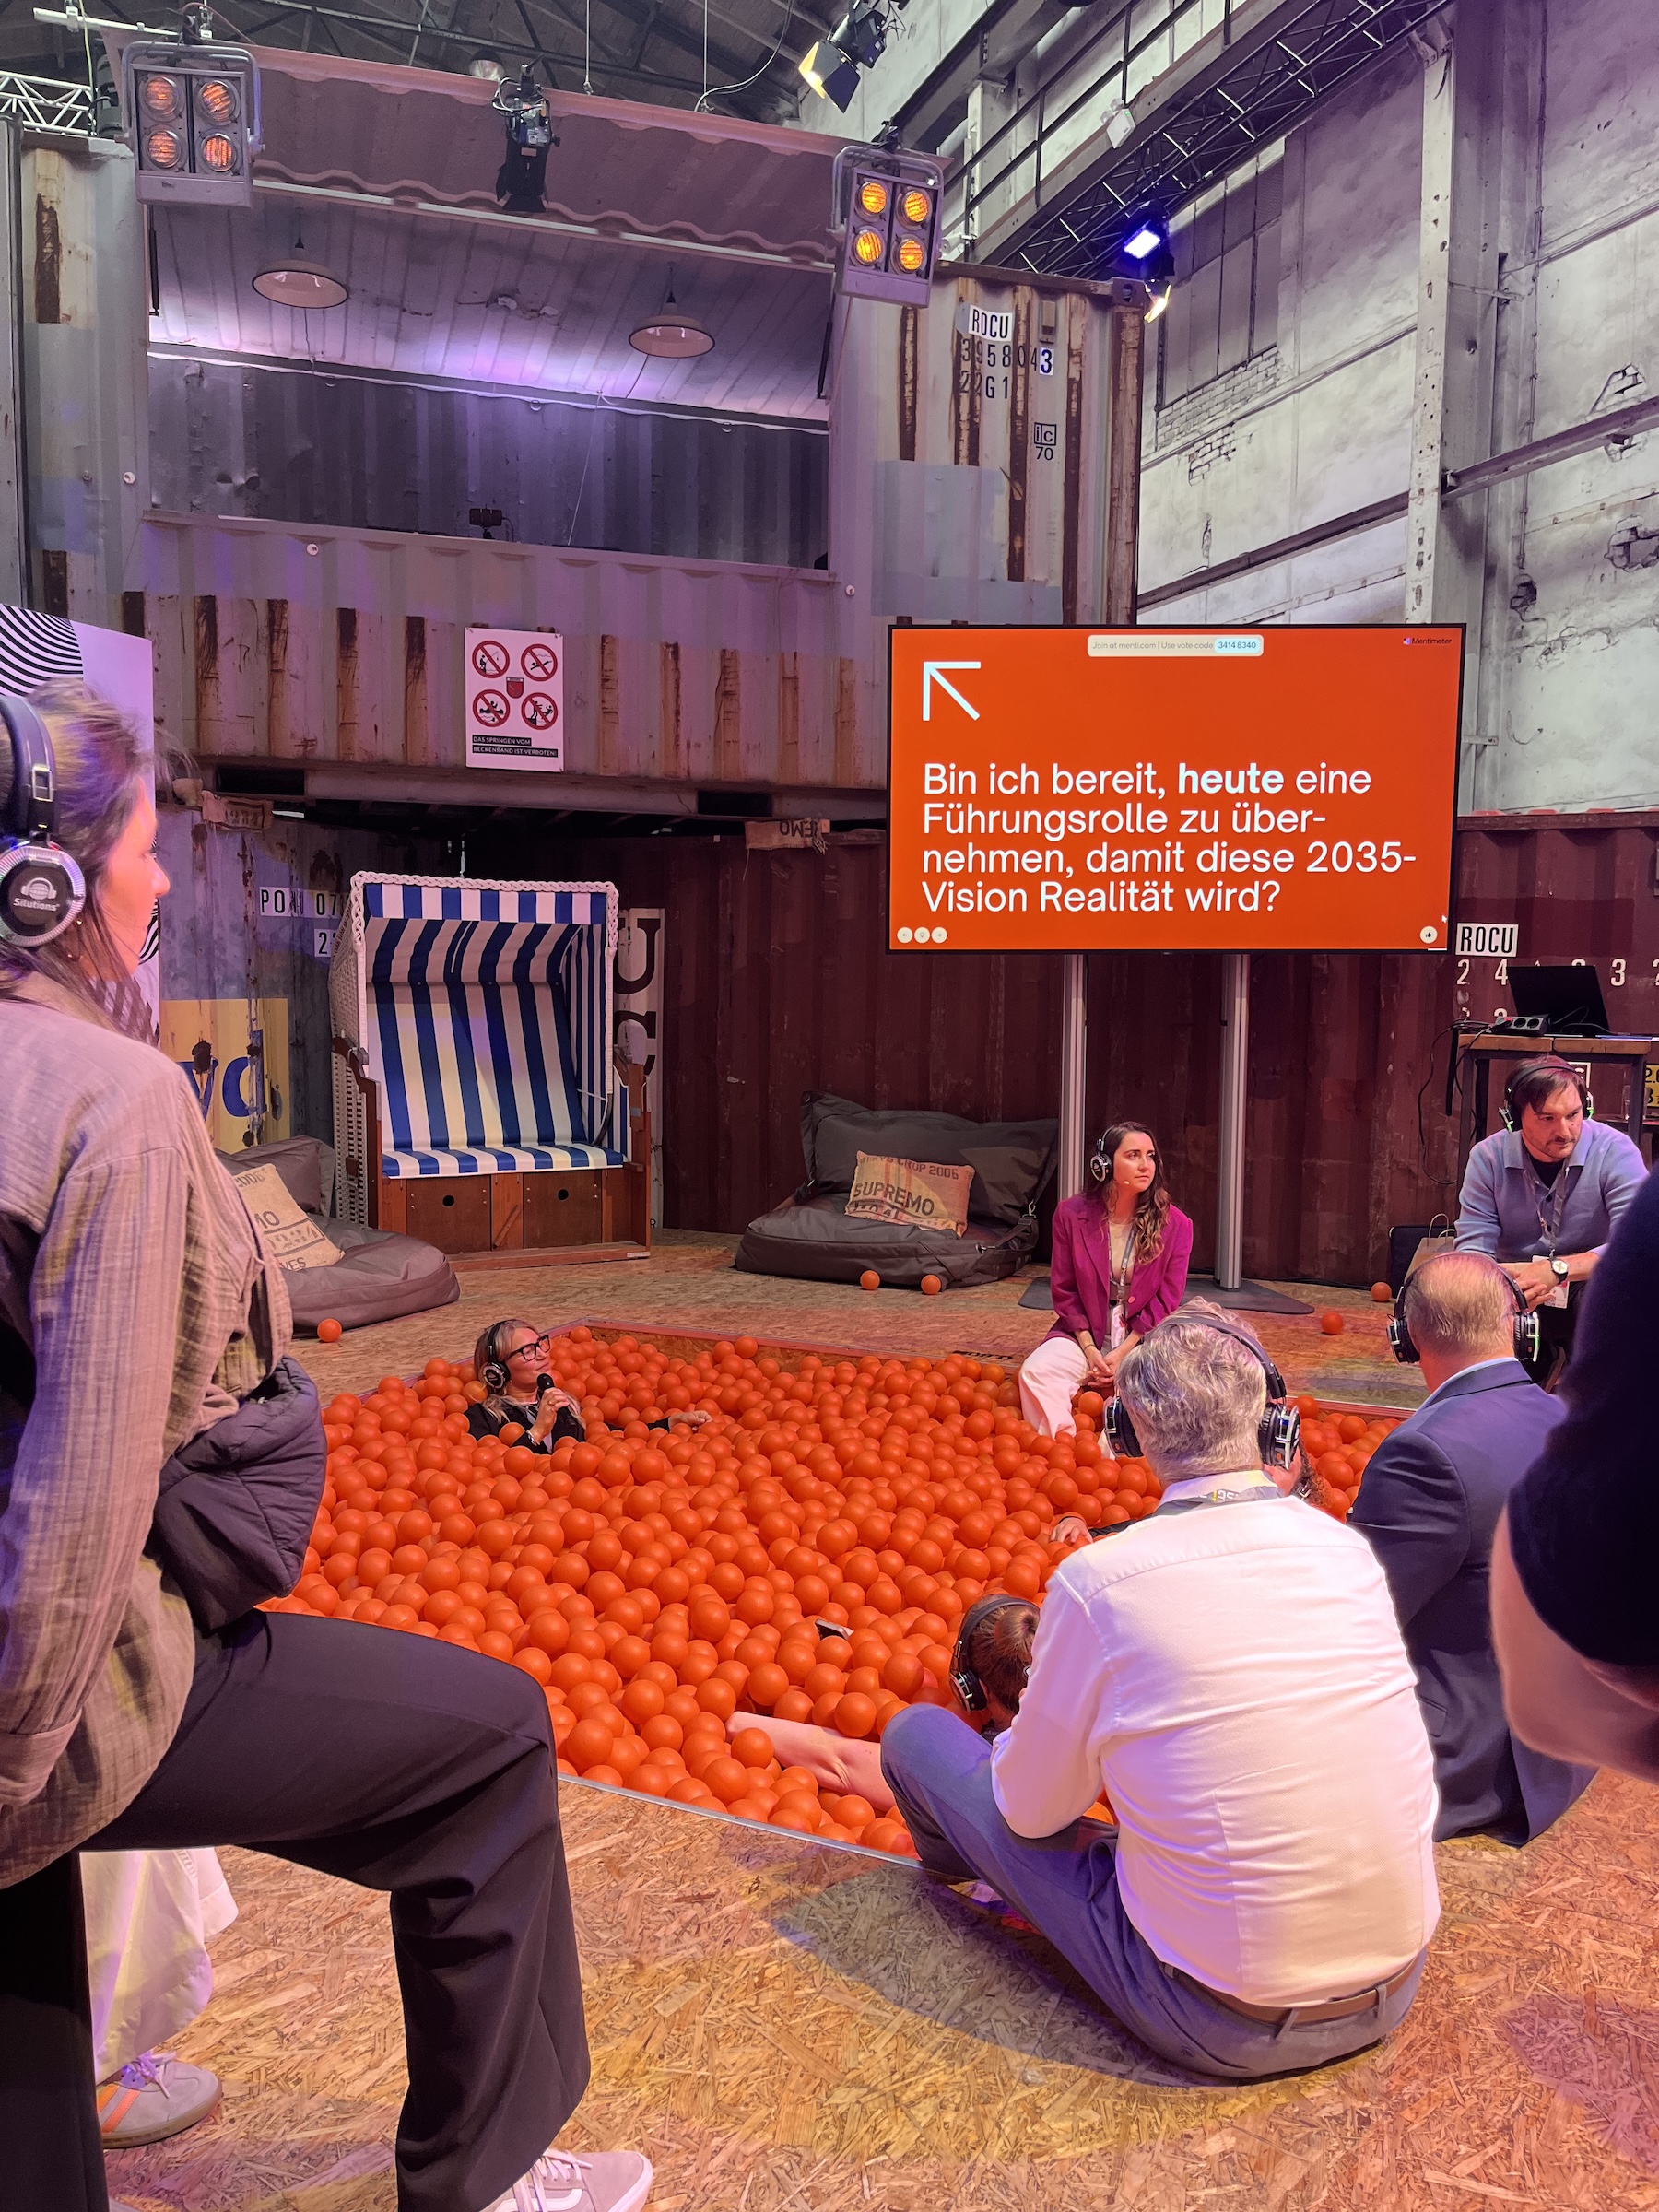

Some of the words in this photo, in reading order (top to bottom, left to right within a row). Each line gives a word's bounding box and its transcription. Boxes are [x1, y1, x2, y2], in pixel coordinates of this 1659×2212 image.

[972, 309, 1009, 339] ROCU
[1036, 446, 1054, 462] 70
[1092, 641, 1109, 650] Join
[1118, 641, 1157, 650] menti.com
[1160, 641, 1176, 650] Use
[1176, 641, 1194, 650] vote
[1194, 641, 1214, 650] code
[1218, 641, 1236, 649] 3414
[1237, 641, 1257, 649] 8340
[1411, 637, 1453, 645] Mentimeter
[473, 746, 514, 754] BECKENRAND
[924, 762, 977, 794] Bin
[989, 762, 1040, 794] ich
[1052, 761, 1166, 800] bereit,
[1178, 762, 1285, 794] heute
[1295, 761, 1371, 794] eine
[924, 802, 1168, 842] Führungsrolle
[1179, 809, 1219, 834] zu
[1231, 801, 1326, 834] über-
[923, 841, 1074, 879] nehmen,
[1086, 841, 1185, 873] damit
[1196, 841, 1295, 873] diese
[1306, 841, 1417, 873] 2035-
[922, 880, 1028, 912] Vision
[1040, 880, 1174, 912] Realität
[1184, 880, 1281, 912] wird?
[1459, 925, 1514, 954] ROCU
[929, 1166, 959, 1180] 2006
[853, 1182, 935, 1217] SUPREMO
